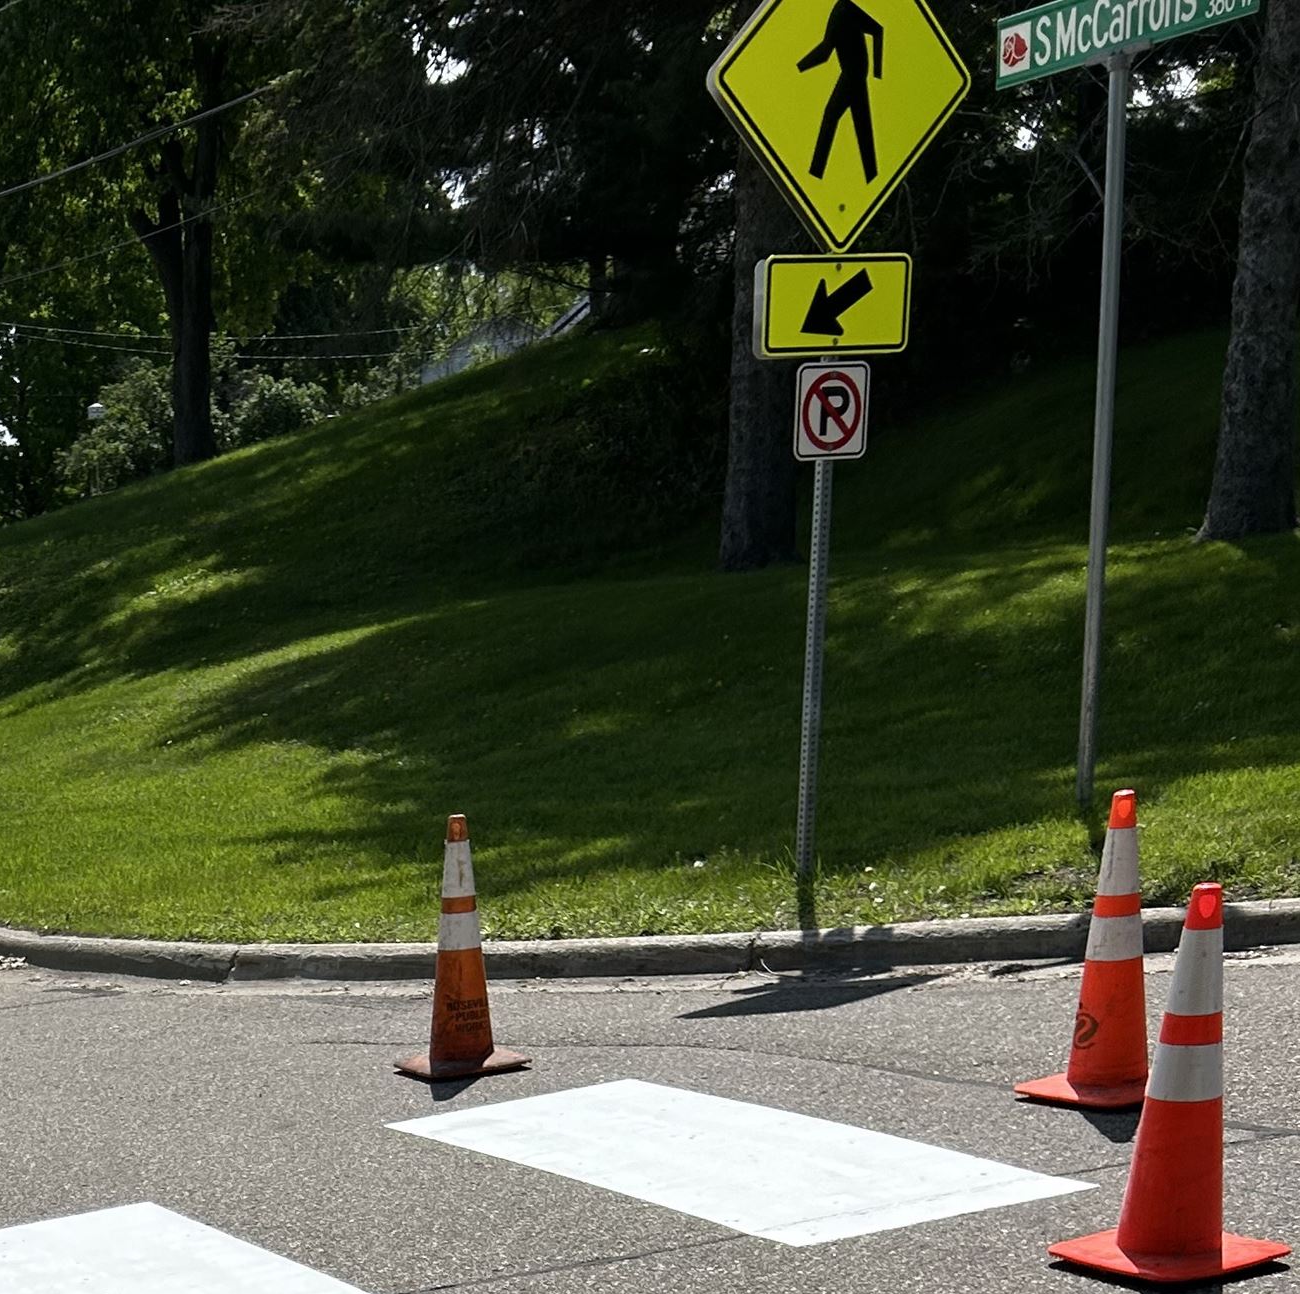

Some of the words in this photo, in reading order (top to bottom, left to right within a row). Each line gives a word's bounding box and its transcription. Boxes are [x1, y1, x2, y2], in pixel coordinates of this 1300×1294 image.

[1034, 15, 1051, 66] S
[1055, 0, 1197, 61] McCarrons
[819, 386, 850, 436] P
